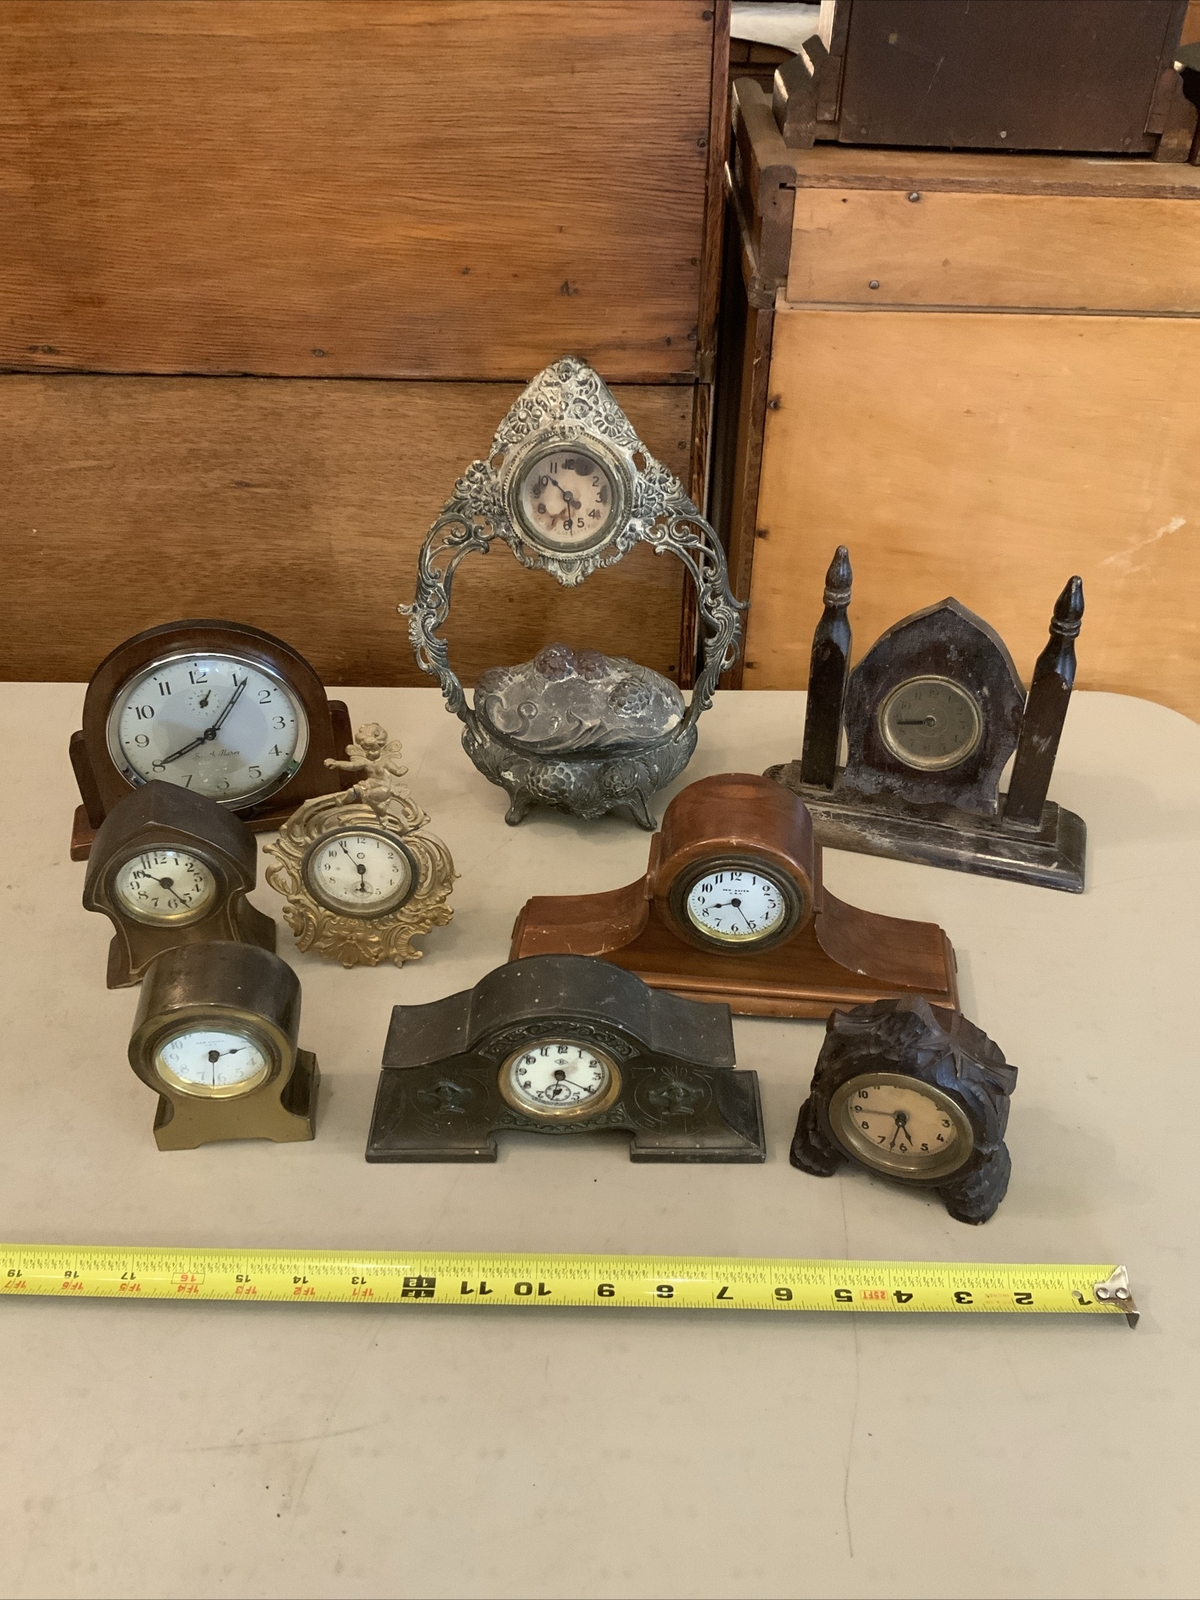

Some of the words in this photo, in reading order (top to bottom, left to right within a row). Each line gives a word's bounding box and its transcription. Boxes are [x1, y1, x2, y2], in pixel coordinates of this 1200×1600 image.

[550, 462, 558, 474] 11
[564, 458, 575, 470] 12
[538, 475, 549, 487] 10
[592, 476, 600, 487] 2
[595, 492, 603, 503] 3
[588, 509, 596, 519] 4
[563, 520, 571, 531] 6
[577, 518, 585, 528] 5
[188, 671, 208, 684] 12
[232, 673, 238, 687] 1
[158, 681, 172, 696] 11
[257, 690, 272, 704] 2
[135, 704, 155, 720] 10
[272, 716, 286, 730] 3
[134, 734, 150, 748] 9
[268, 744, 282, 756] 4
[151, 759, 166, 773] 8
[248, 765, 262, 779] 5
[181, 774, 193, 788] 7
[328, 850, 337, 858] 10
[387, 852, 394, 860] 2
[174, 858, 179, 866] 1
[324, 863, 331, 871] 9
[185, 862, 195, 873] 2
[132, 870, 146, 879] 10
[193, 872, 203, 882] 3
[715, 873, 724, 885] 11
[730, 872, 742, 881] 12
[130, 881, 140, 890] 9
[752, 876, 756, 886] 1
[701, 883, 713, 893] 10
[762, 885, 771, 896] 2
[138, 891, 149, 900] 8
[183, 892, 193, 903] 5
[698, 896, 706, 905] 9
[151, 897, 159, 907] 7
[168, 899, 178, 909] 6
[767, 898, 776, 909] 3
[702, 908, 710, 918] 8
[760, 911, 769, 920] 4
[714, 917, 722, 927] 7
[731, 922, 738, 932] 6
[748, 920, 756, 929] 5
[170, 1041, 183, 1050] 10
[556, 1045, 568, 1054] 12
[540, 1046, 550, 1057] 11
[577, 1050, 583, 1059] 1
[169, 1053, 180, 1063] 9
[246, 1058, 257, 1066] 4
[525, 1055, 537, 1065] 10
[180, 1064, 190, 1074] 8
[589, 1060, 598, 1068] 2
[196, 1071, 206, 1081] 7
[236, 1068, 244, 1077] 5
[519, 1068, 527, 1076] 9
[592, 1072, 601, 1080] 3
[218, 1073, 227, 1082] 6
[523, 1080, 532, 1090] 8
[571, 1091, 581, 1101] 5
[858, 1090, 869, 1099] 10
[854, 1105, 863, 1113] 9
[861, 1121, 870, 1130] 8
[941, 1119, 950, 1128] 3
[877, 1135, 886, 1144] 7
[936, 1133, 944, 1142] 4
[899, 1143, 908, 1152] 6
[920, 1143, 929, 1152] 5
[7, 1270, 23, 1278] 19
[64, 1271, 80, 1279] 18
[121, 1272, 136, 1280] 17
[181, 1274, 196, 1282] 16
[236, 1274, 251, 1282] 15
[293, 1276, 308, 1284] 14
[409, 1278, 428, 1286] 12
[461, 1281, 493, 1295] 11
[514, 1282, 552, 1296] 10
[598, 1284, 615, 1297] 9
[656, 1285, 673, 1298] 8
[716, 1286, 733, 1300] 7
[775, 1288, 792, 1301] 6
[834, 1289, 853, 1302] 5
[863, 1291, 886, 1299] 25FT
[894, 1291, 913, 1303] 4
[954, 1292, 973, 1304] 3
[1014, 1293, 1034, 1305] 2
[1076, 1293, 1092, 1305] 1
